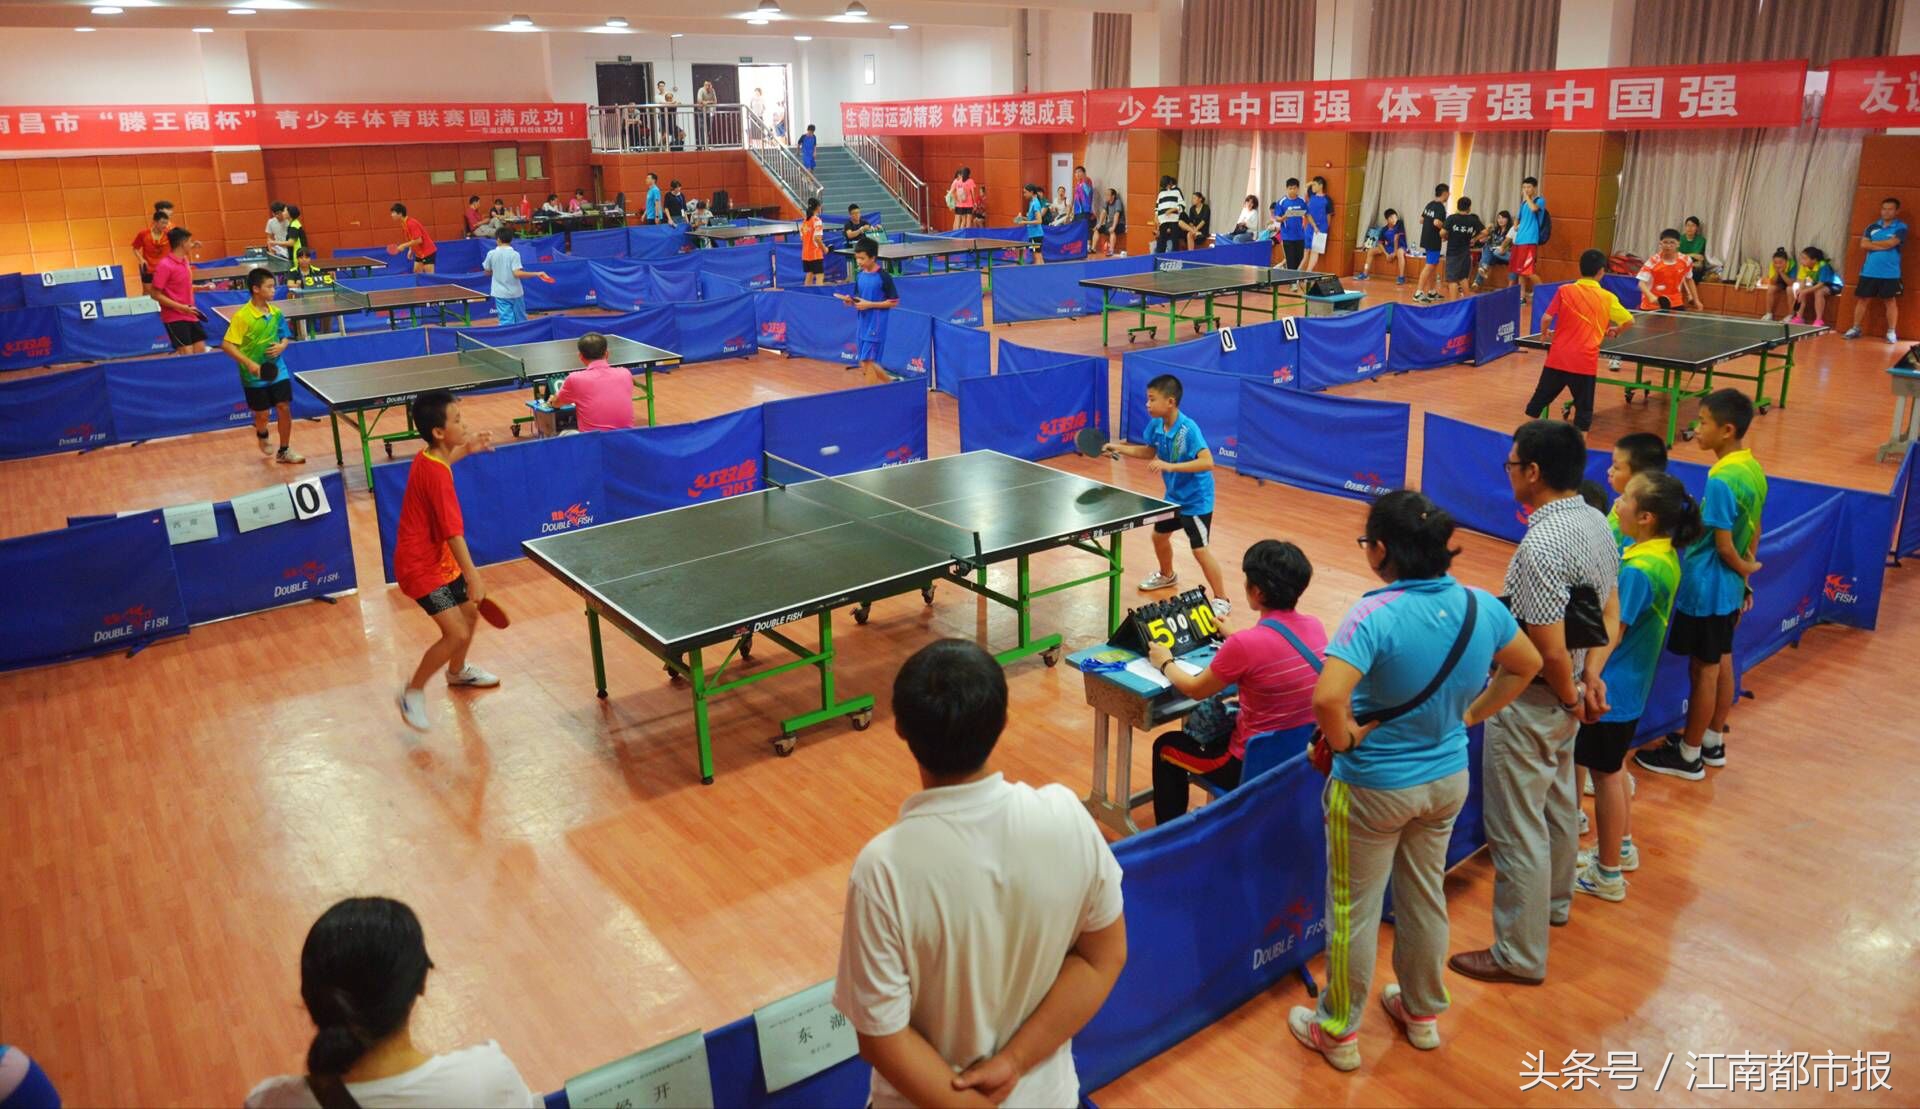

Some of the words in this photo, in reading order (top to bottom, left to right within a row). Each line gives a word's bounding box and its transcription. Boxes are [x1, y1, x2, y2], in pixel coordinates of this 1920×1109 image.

[845, 105, 943, 129] 生命因运动精彩
[952, 99, 1074, 128] 体育让梦想成真
[1117, 88, 1351, 127] 少年强中国强
[1377, 74, 1738, 123] 体育强中国强
[43, 272, 53, 285] 0
[101, 267, 109, 278] 1
[83, 302, 97, 317] 2
[1221, 330, 1234, 349] 0
[1285, 320, 1295, 337] 0
[295, 483, 321, 514] 0
[541, 520, 571, 533] DOUBLE
[577, 515, 594, 526] FISH
[273, 579, 309, 598] DOUBLE
[317, 572, 338, 586] FISH
[1834, 591, 1858, 604] FISH
[93, 624, 133, 643] DOUBLE
[144, 616, 169, 632] FISH
[753, 615, 786, 633] DOUBLE
[786, 611, 803, 623] FISH
[1147, 618, 1175, 650] 5
[1190, 604, 1218, 637] 10
[1252, 934, 1296, 971] DOUBLE
[1304, 917, 1327, 941] FIS
